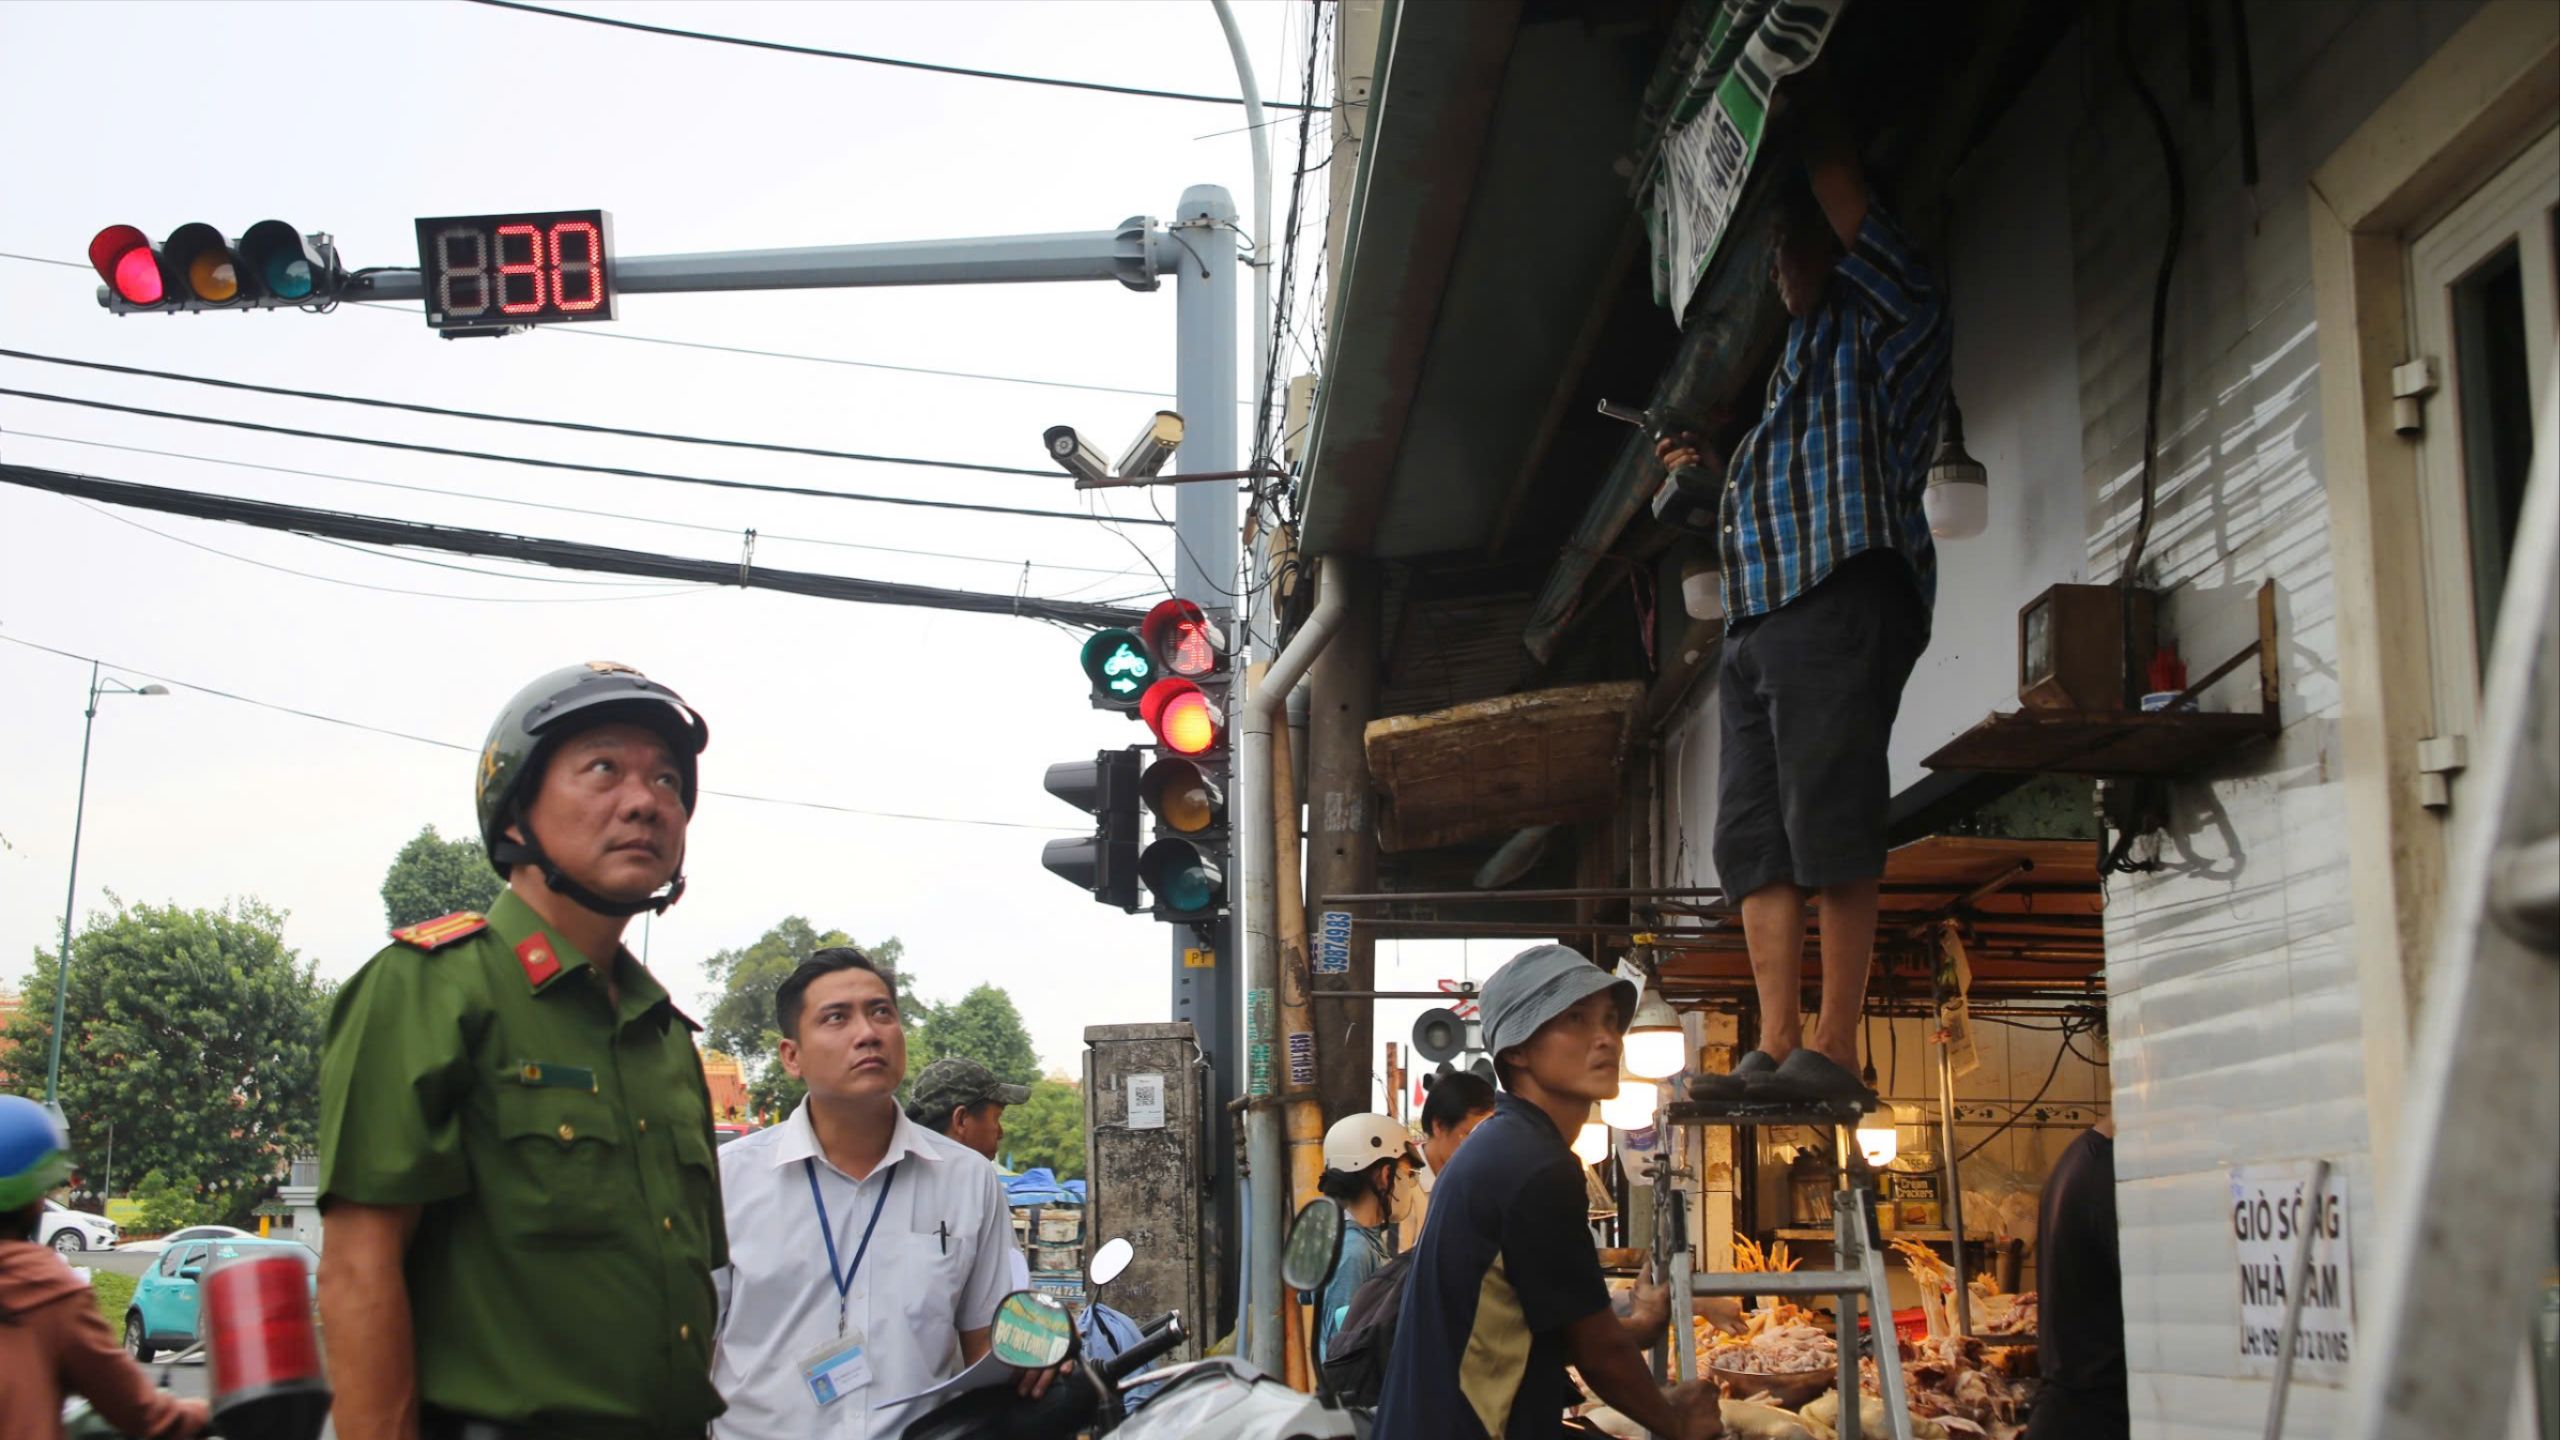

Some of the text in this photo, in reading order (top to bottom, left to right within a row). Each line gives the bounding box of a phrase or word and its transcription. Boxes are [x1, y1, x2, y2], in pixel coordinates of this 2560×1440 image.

[498, 222, 602, 314] 30
[2234, 1188, 2271, 1241] GIÒ
[2240, 1254, 2288, 1306] NHÀ
